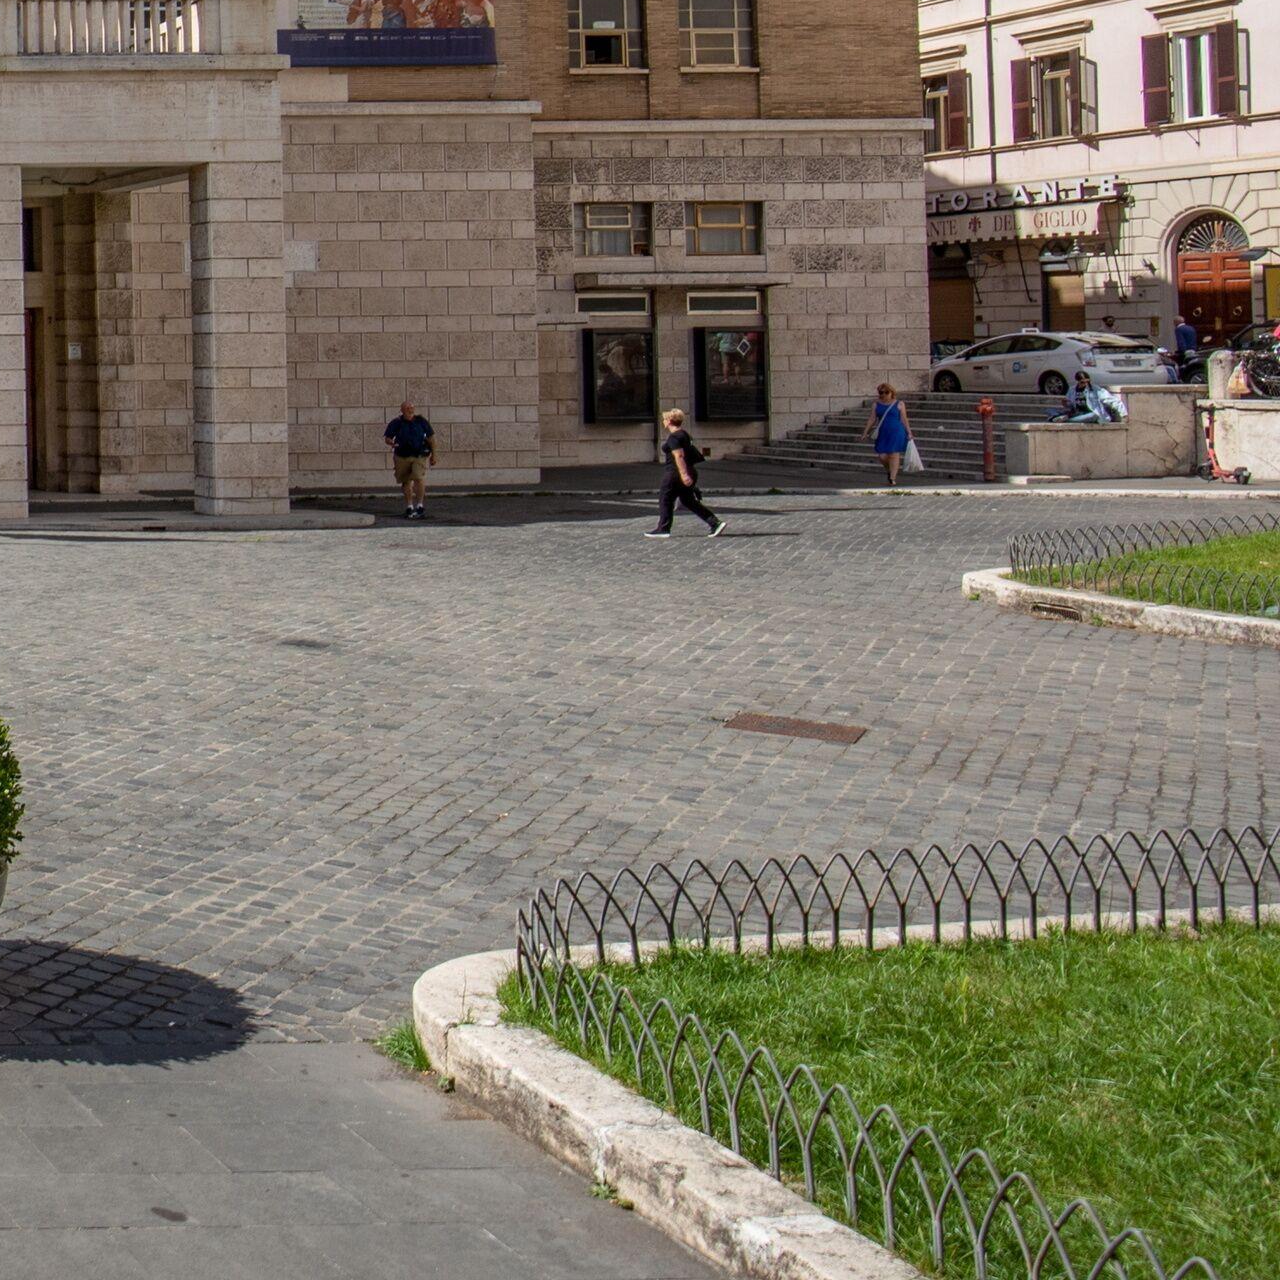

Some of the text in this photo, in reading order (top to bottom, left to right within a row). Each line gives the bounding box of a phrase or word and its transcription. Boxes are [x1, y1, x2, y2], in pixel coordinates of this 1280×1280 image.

[927, 209, 1087, 237] NTE DEL GIGLIO
